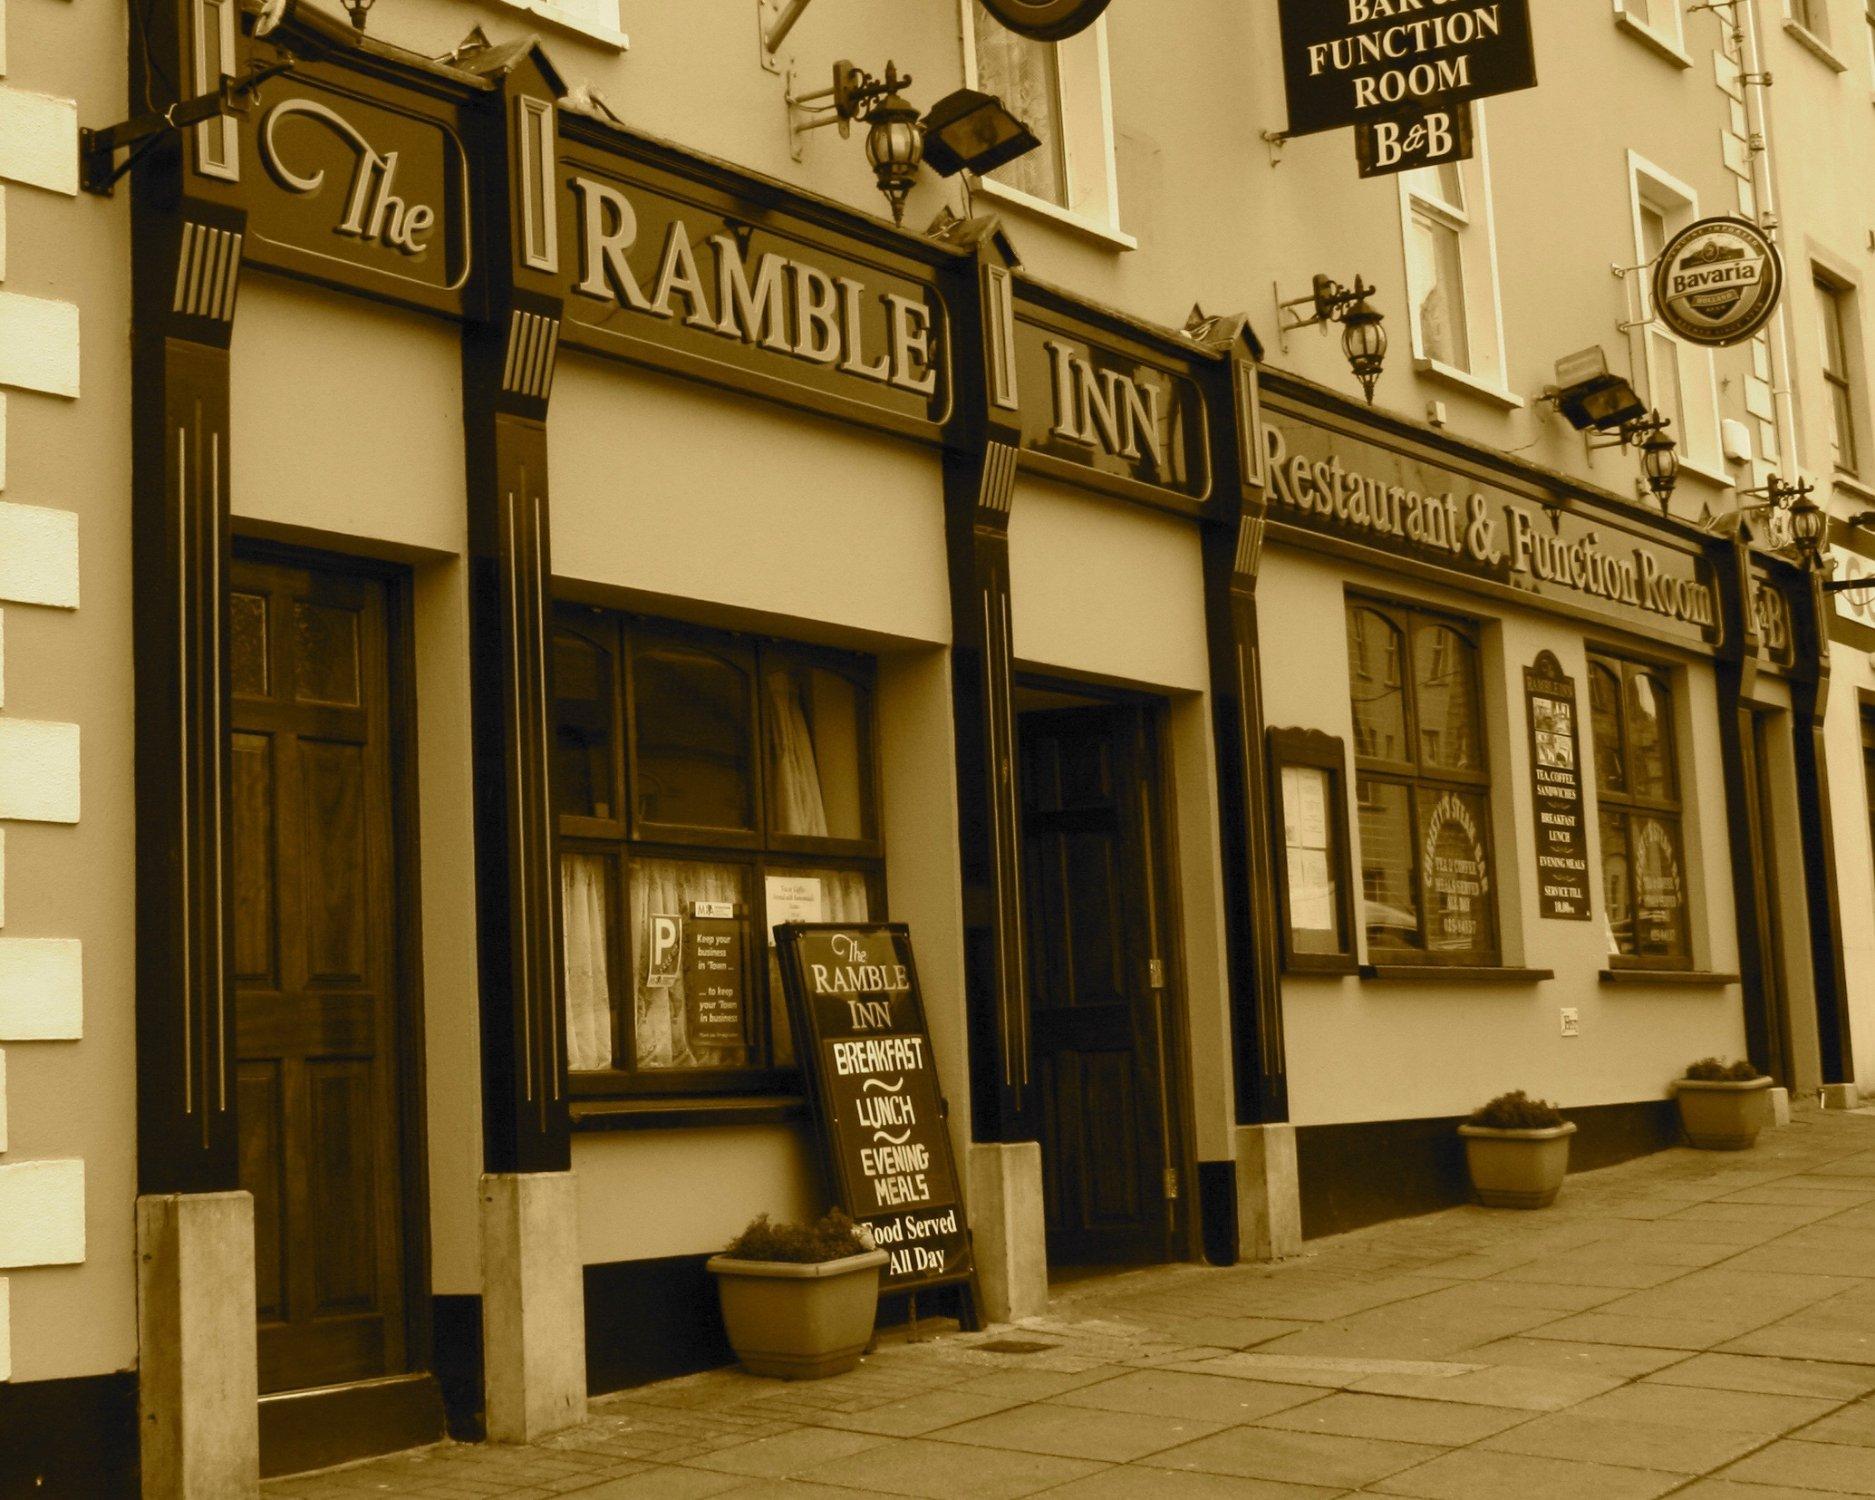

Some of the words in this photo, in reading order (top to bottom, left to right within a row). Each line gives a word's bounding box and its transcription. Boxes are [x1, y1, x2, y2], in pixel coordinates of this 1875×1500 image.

[1308, 5, 1500, 76] FUNCTION
[1354, 55, 1470, 109] ROOM
[1375, 111, 1452, 167] B&B
[265, 98, 434, 254] The
[574, 177, 936, 394] RAMBLE
[1044, 340, 1161, 466] INN
[1673, 263, 1755, 293] Bavaria
[1262, 422, 1461, 553] Restaurant
[1467, 493, 1501, 565] &
[1505, 505, 1637, 606] Function
[1633, 549, 1714, 627] Room
[1537, 785, 1576, 800] SANDWICHES
[1541, 812, 1575, 826] BREAKFAST
[1549, 830, 1570, 843] LUNCH
[1540, 856, 1565, 868] EVENING
[655, 918, 676, 965] P
[697, 934, 714, 945] Keep
[715, 936, 731, 946] your
[698, 947, 726, 957] business
[831, 933, 867, 963] The
[698, 961, 705, 970] in
[811, 964, 909, 993] RAMBLE
[699, 1002, 716, 1011] your
[708, 987, 716, 995] to
[717, 987, 733, 997] keep
[700, 1013, 707, 1022] in
[709, 1013, 737, 1022] business
[848, 1001, 892, 1029] INN
[833, 1037, 923, 1075] BREAKFAST
[856, 1095, 916, 1128] LUNCH
[860, 1143, 929, 1176] EVENING
[874, 1174, 930, 1206] MEALS
[905, 1210, 957, 1240] Served
[889, 1249, 913, 1276] All
[914, 1247, 945, 1273] Day
